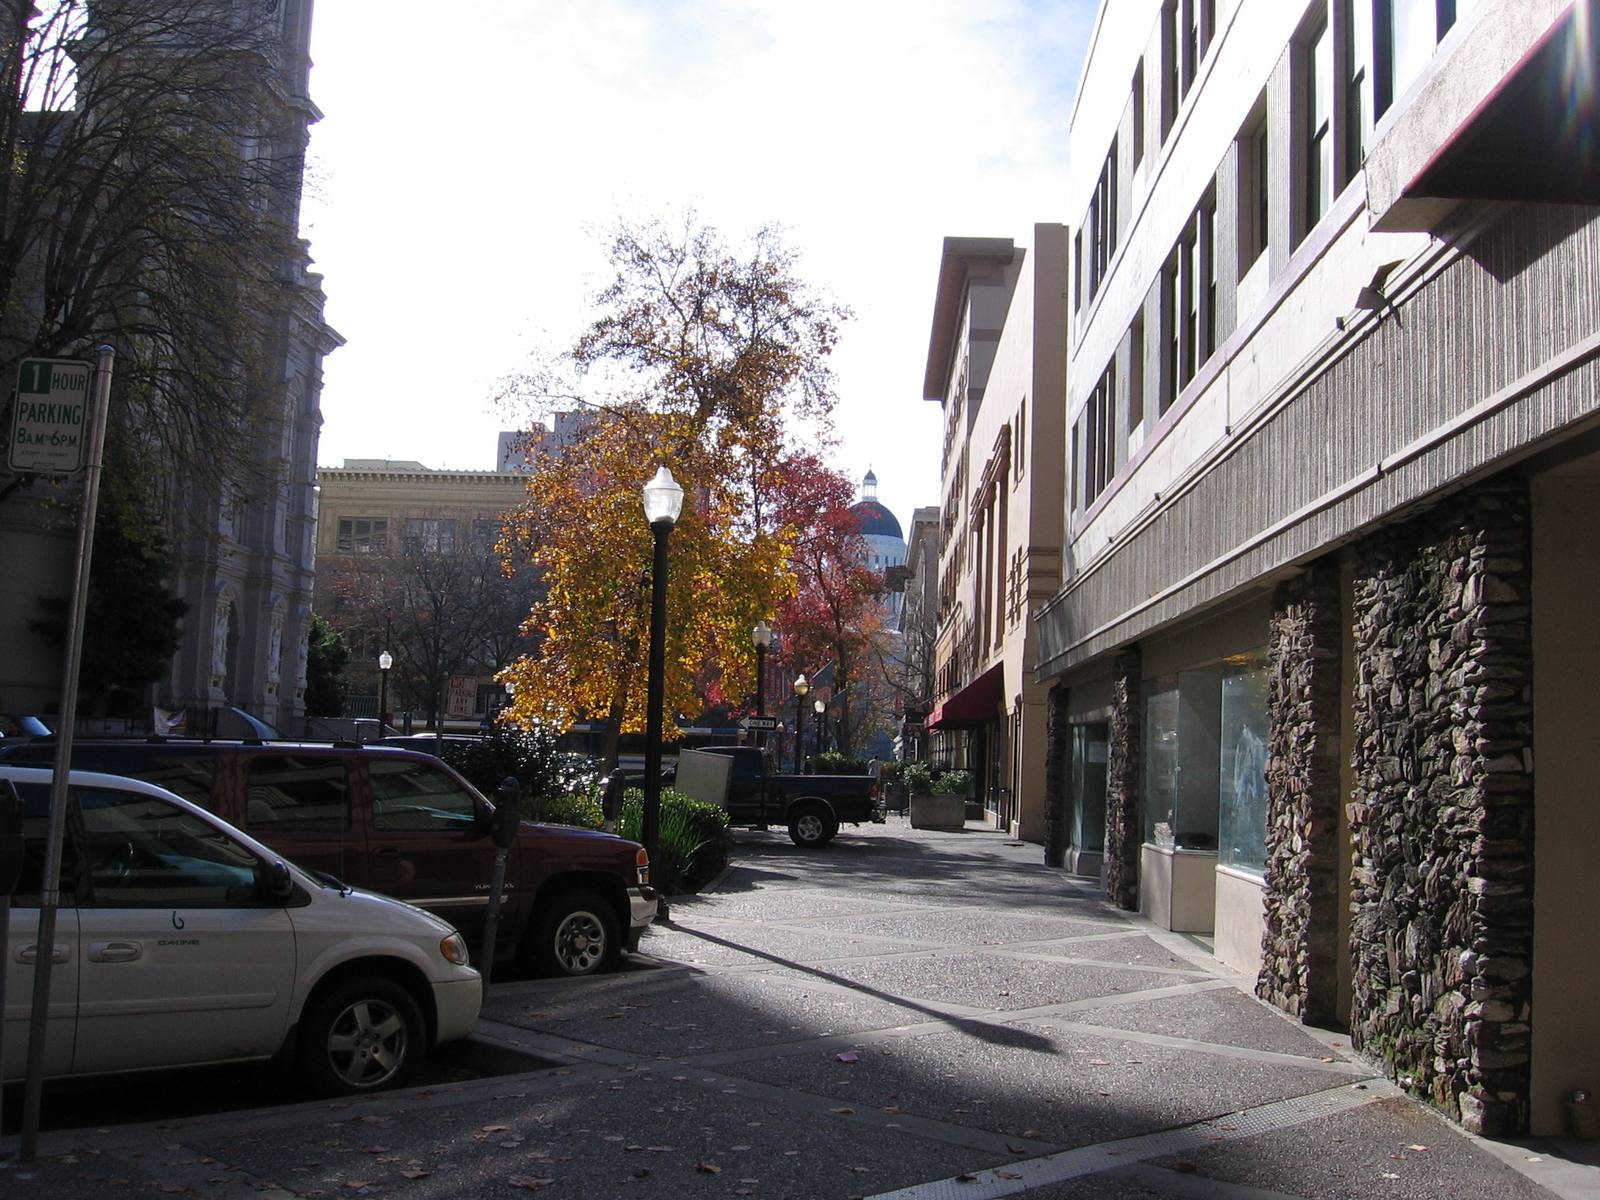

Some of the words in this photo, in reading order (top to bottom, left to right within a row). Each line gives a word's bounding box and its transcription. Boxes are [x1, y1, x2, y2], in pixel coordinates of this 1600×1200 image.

[32, 364, 41, 391] 1
[51, 372, 86, 391] HOUR
[18, 402, 82, 425] PARKING
